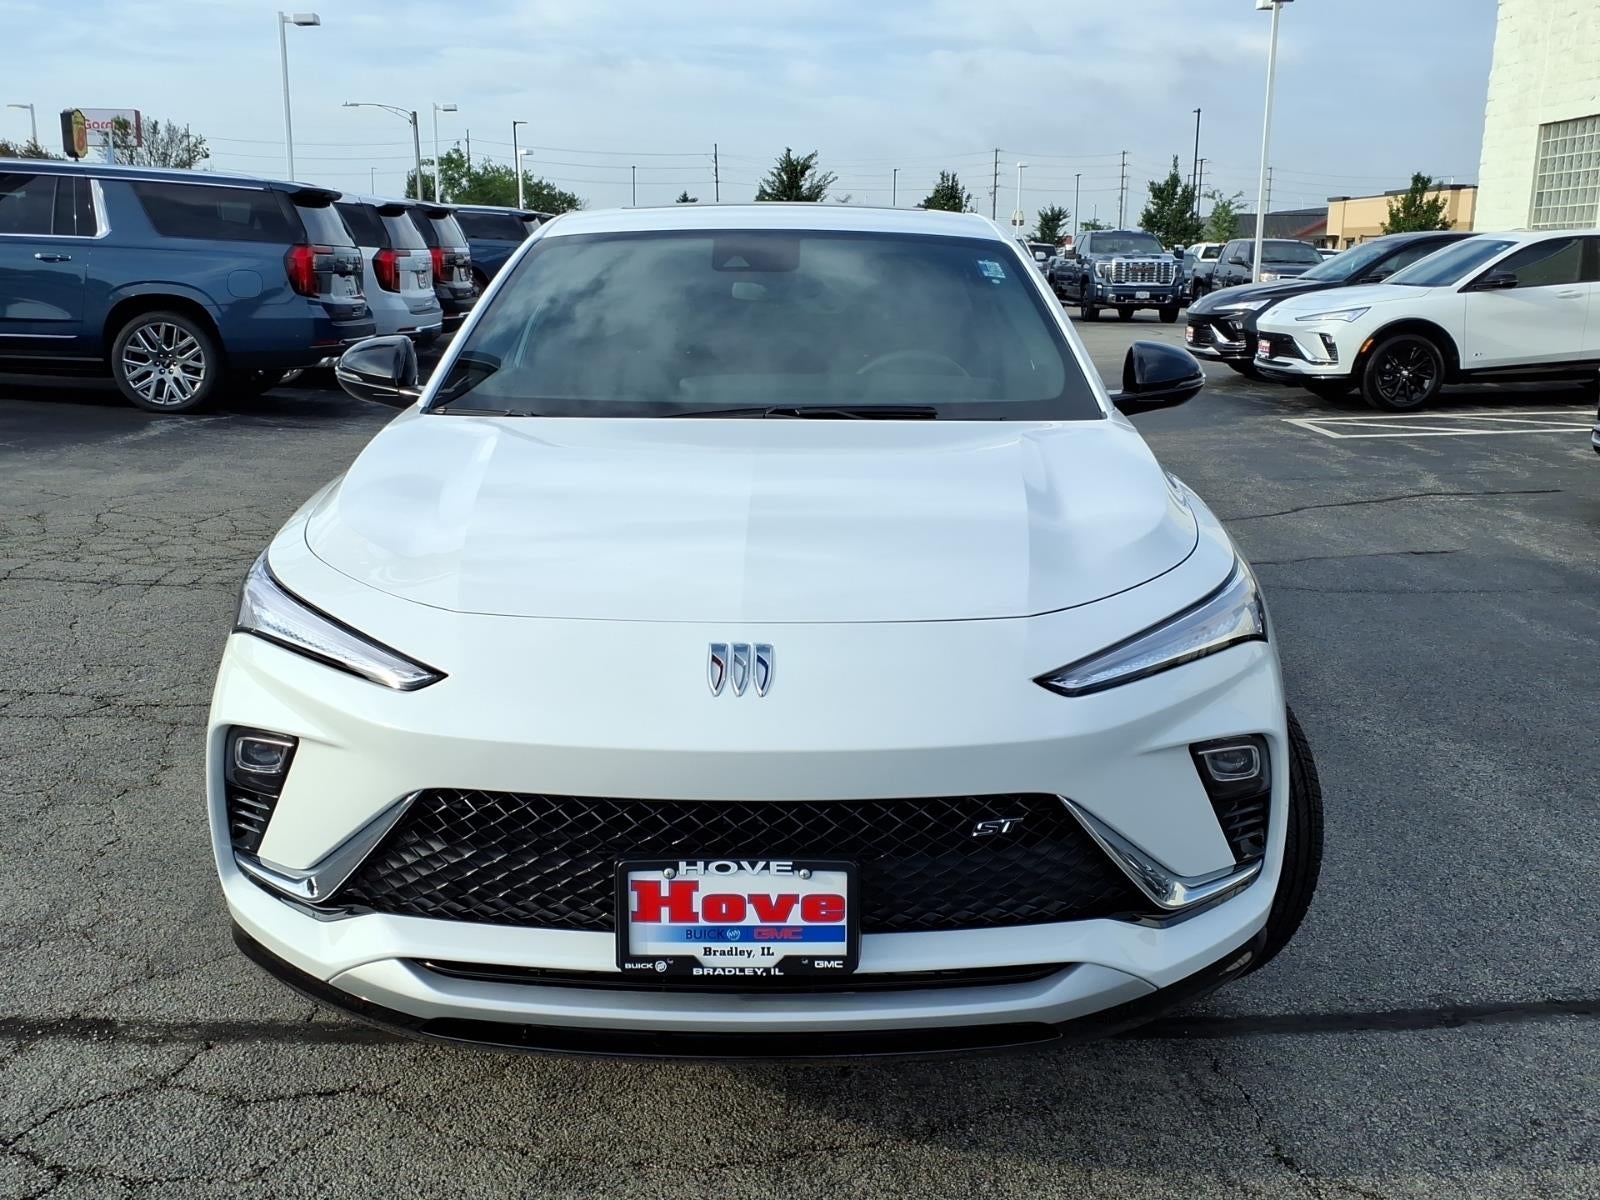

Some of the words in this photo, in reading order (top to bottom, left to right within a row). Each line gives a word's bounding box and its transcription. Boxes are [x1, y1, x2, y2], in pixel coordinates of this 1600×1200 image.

[678, 861, 794, 876] HOVE
[631, 880, 846, 923] Hove
[685, 928, 726, 940] BUICK
[753, 927, 804, 940] GMC
[703, 946, 756, 958] Bradley,
[760, 946, 775, 957] IL
[814, 960, 844, 968] GMC
[692, 967, 767, 976] BRADLEY,
[770, 967, 785, 976] IL
